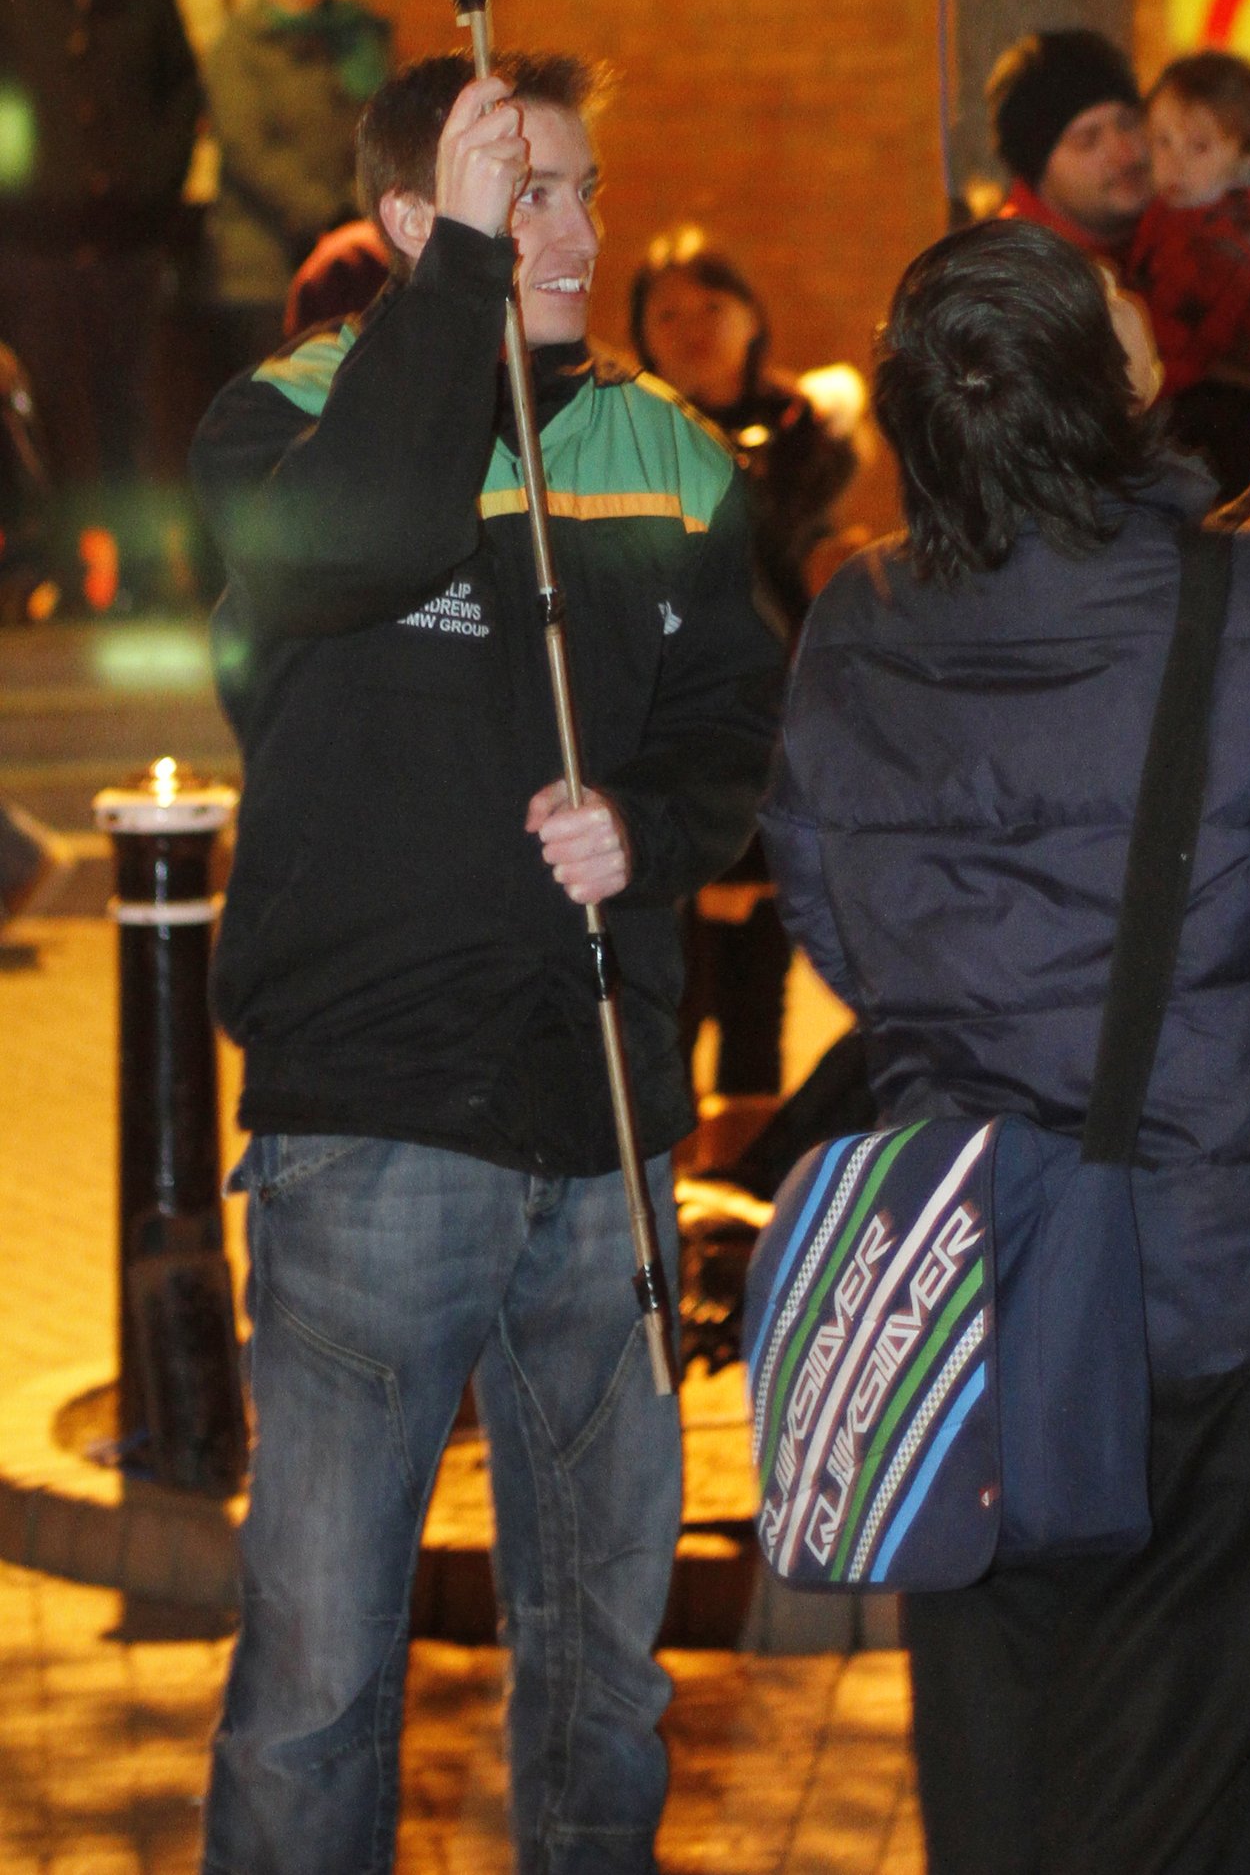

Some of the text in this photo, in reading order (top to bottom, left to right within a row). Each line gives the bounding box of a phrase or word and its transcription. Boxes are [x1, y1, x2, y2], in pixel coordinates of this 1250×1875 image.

[424, 597, 482, 622] DREWS
[397, 611, 491, 639] MW GROUP
